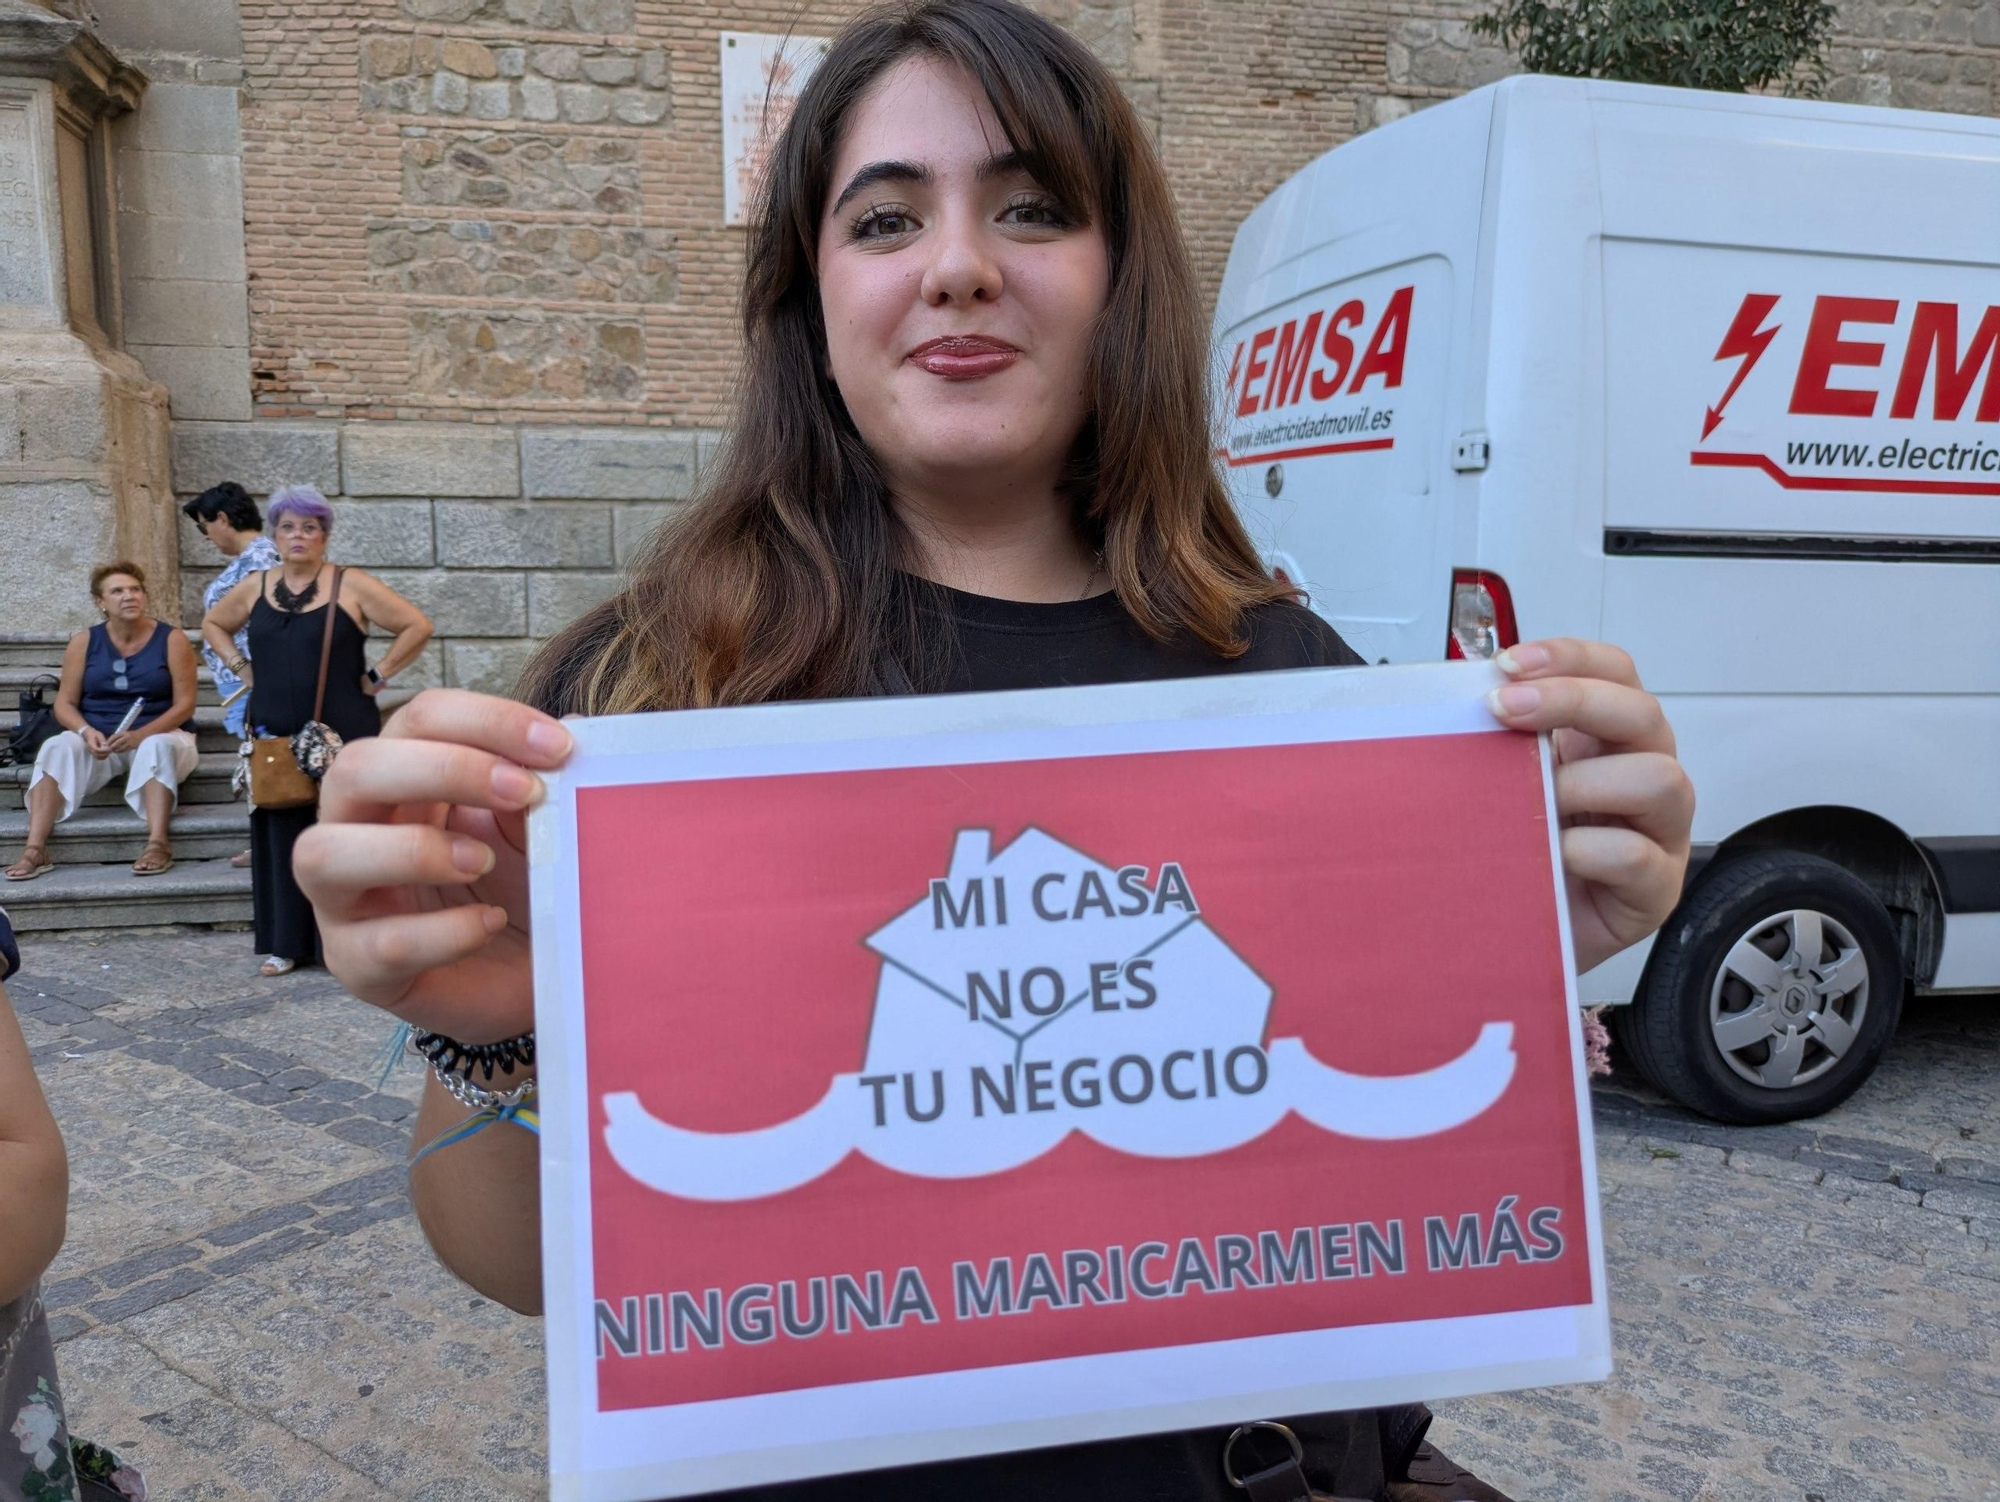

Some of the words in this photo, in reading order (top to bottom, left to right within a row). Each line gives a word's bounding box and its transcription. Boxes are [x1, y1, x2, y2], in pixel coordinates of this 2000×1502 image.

[1236, 285, 1414, 417] EMSA
[1231, 405, 1394, 450] www.electricidadmovil.es
[930, 876, 1008, 930] MI
[1030, 862, 1198, 922] CASA
[966, 966, 1065, 1022] NO
[1089, 959, 1158, 1013] ES
[859, 1070, 945, 1127] TU
[970, 1045, 1268, 1118] NEGOCIO
[595, 1267, 939, 1358] NINGUNA
[953, 1219, 1406, 1320] MARICARMEN
[1424, 1196, 1565, 1271] MÁS
